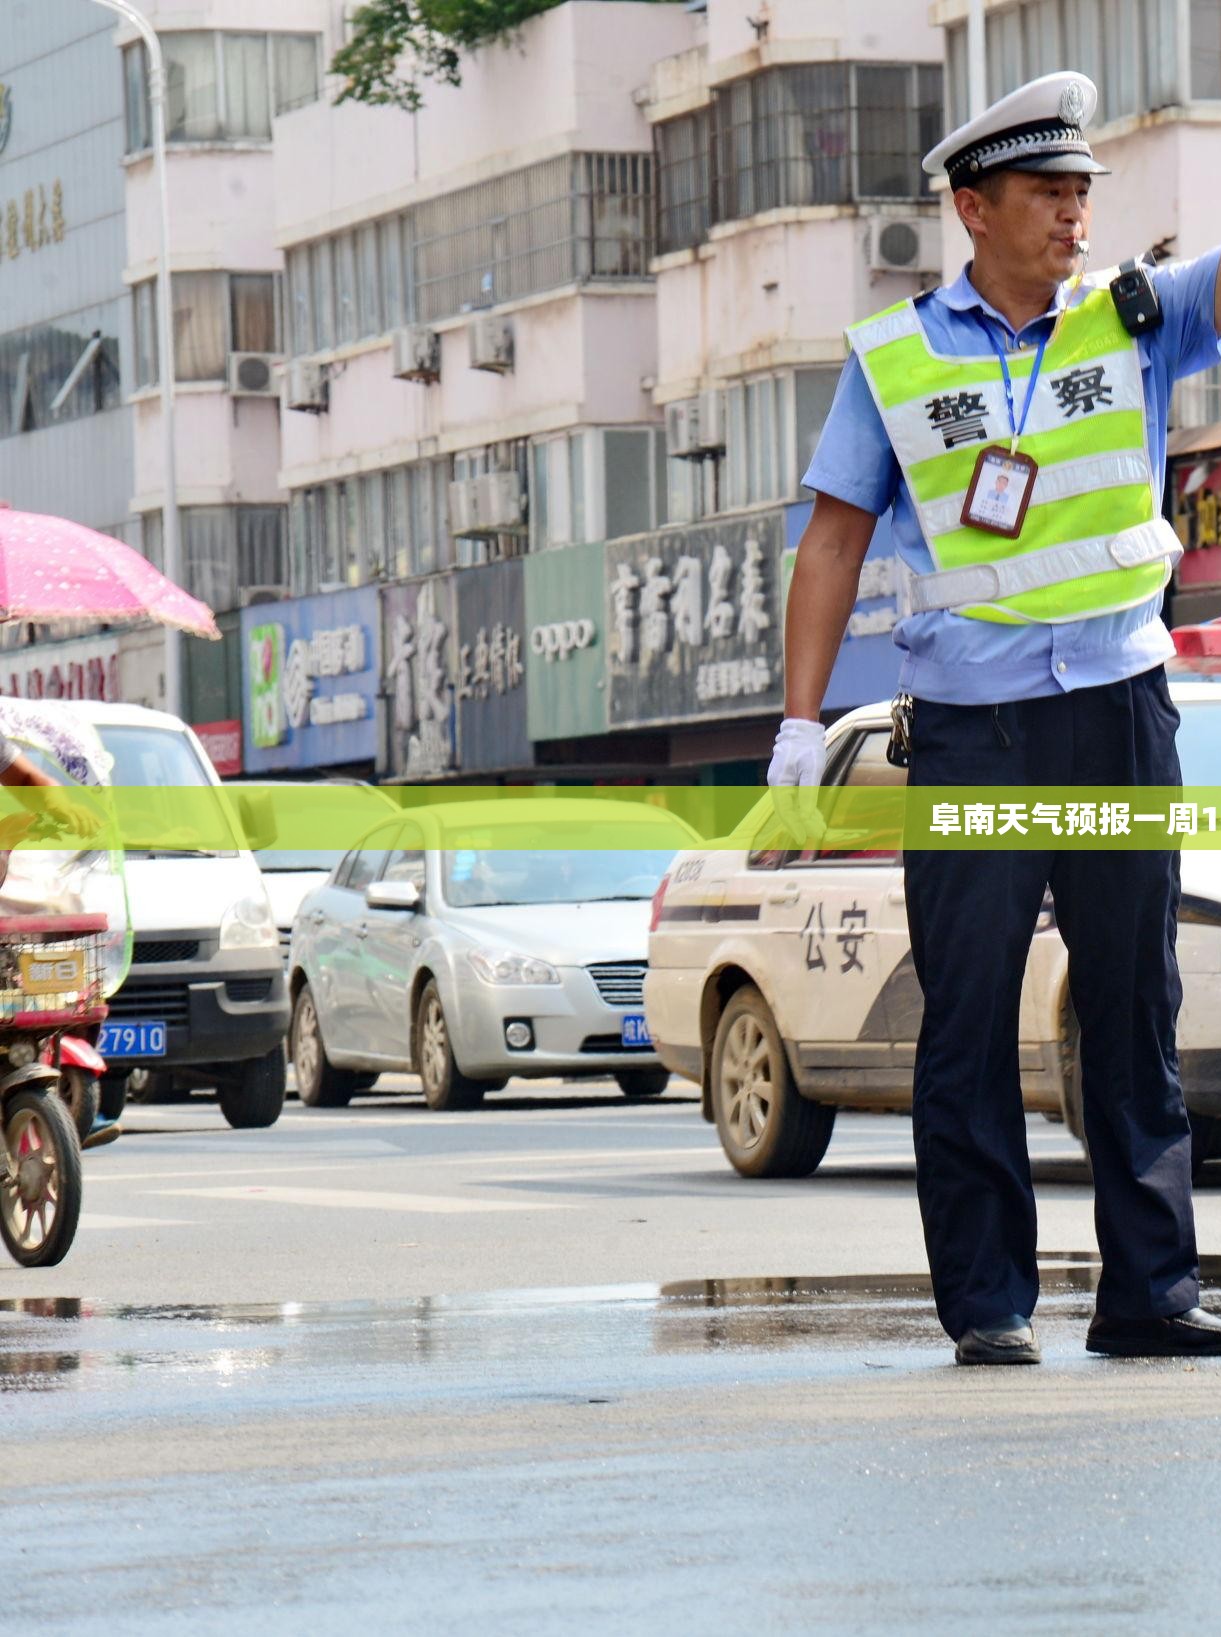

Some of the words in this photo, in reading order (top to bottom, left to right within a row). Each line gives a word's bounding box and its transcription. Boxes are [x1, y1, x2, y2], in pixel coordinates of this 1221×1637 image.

[531, 618, 594, 663] oppo
[799, 899, 868, 975] 公安
[28, 960, 78, 982] 新日
